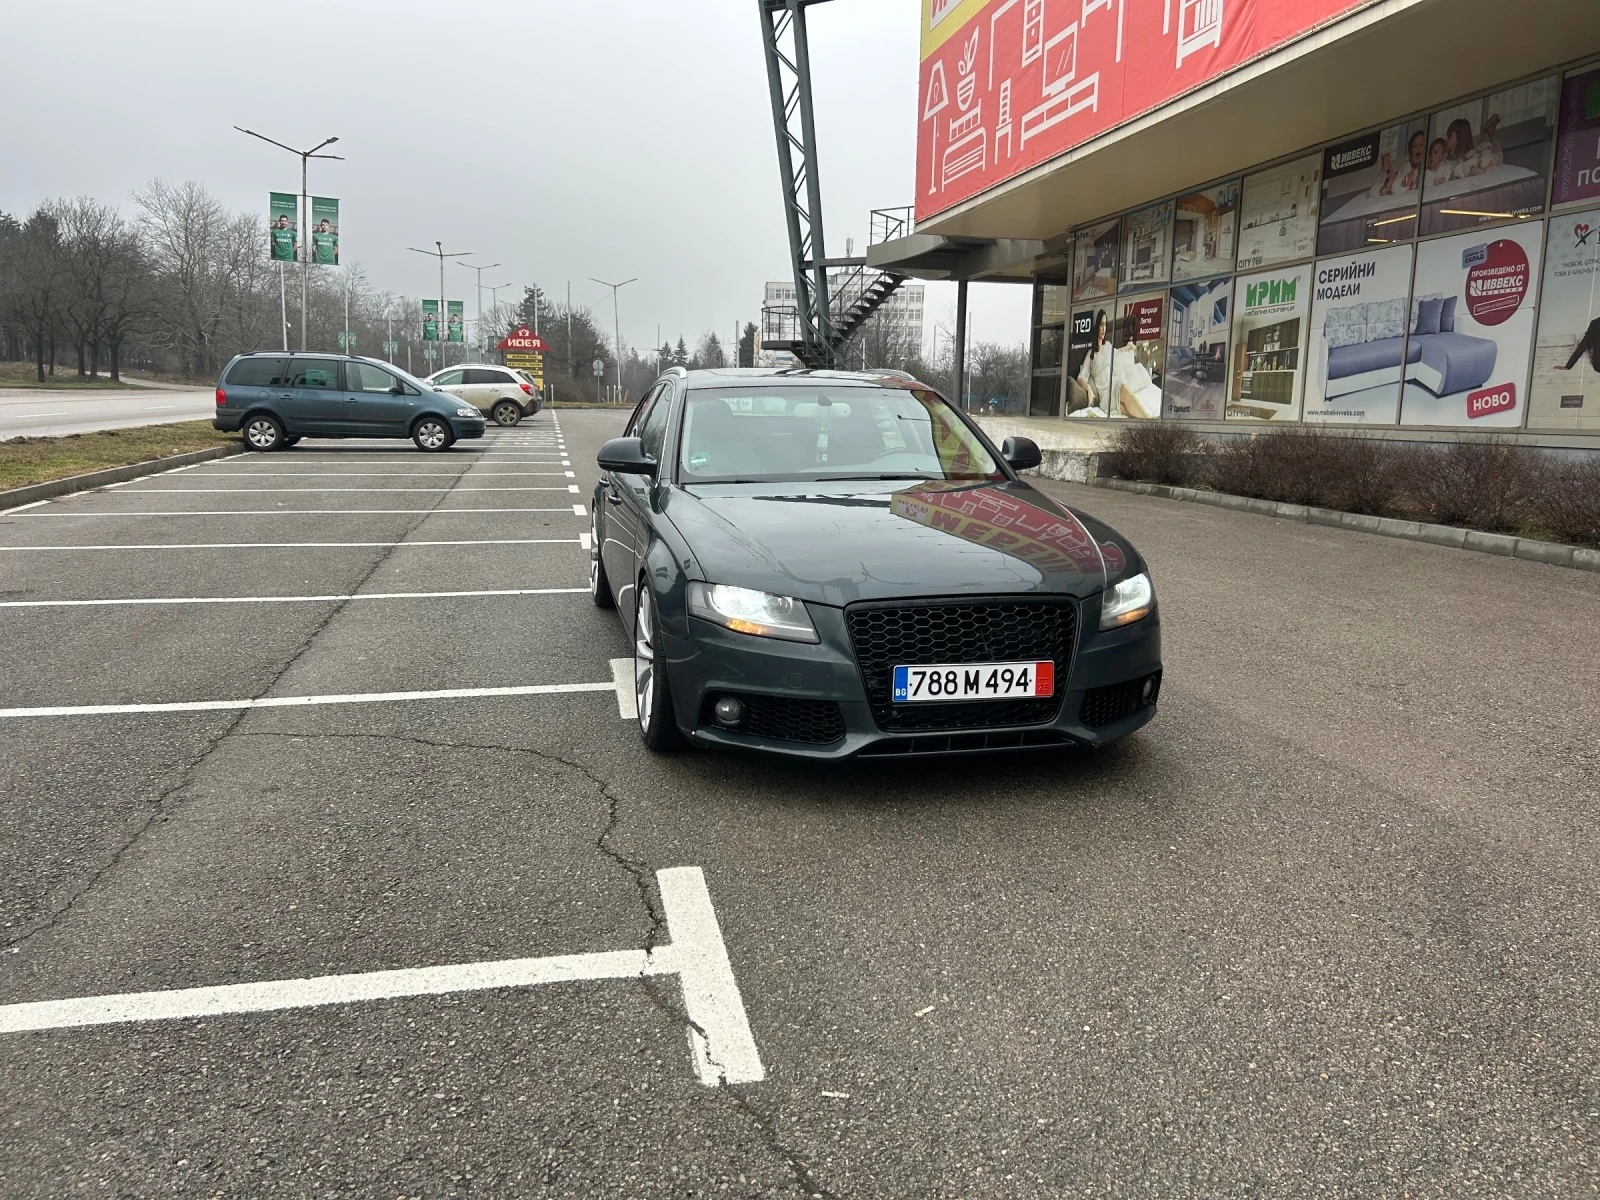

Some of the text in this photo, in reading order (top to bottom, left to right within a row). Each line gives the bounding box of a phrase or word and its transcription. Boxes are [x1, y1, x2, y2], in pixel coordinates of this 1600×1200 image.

[1341, 145, 1372, 163] ИВВЕКС
[1238, 258, 1252, 269] CITY
[1471, 263, 1526, 278] ПРОИЗВЕДЕНО ОТ
[1318, 261, 1376, 285] СЕРИЙНИ
[1483, 275, 1524, 290] ИВВЕКС
[1245, 276, 1297, 308] ИРИМ
[1316, 283, 1361, 301] МОДЕЛИ
[1473, 391, 1510, 411] НОВО
[912, 667, 1029, 697] 788 M 494
[895, 688, 907, 697] BG
